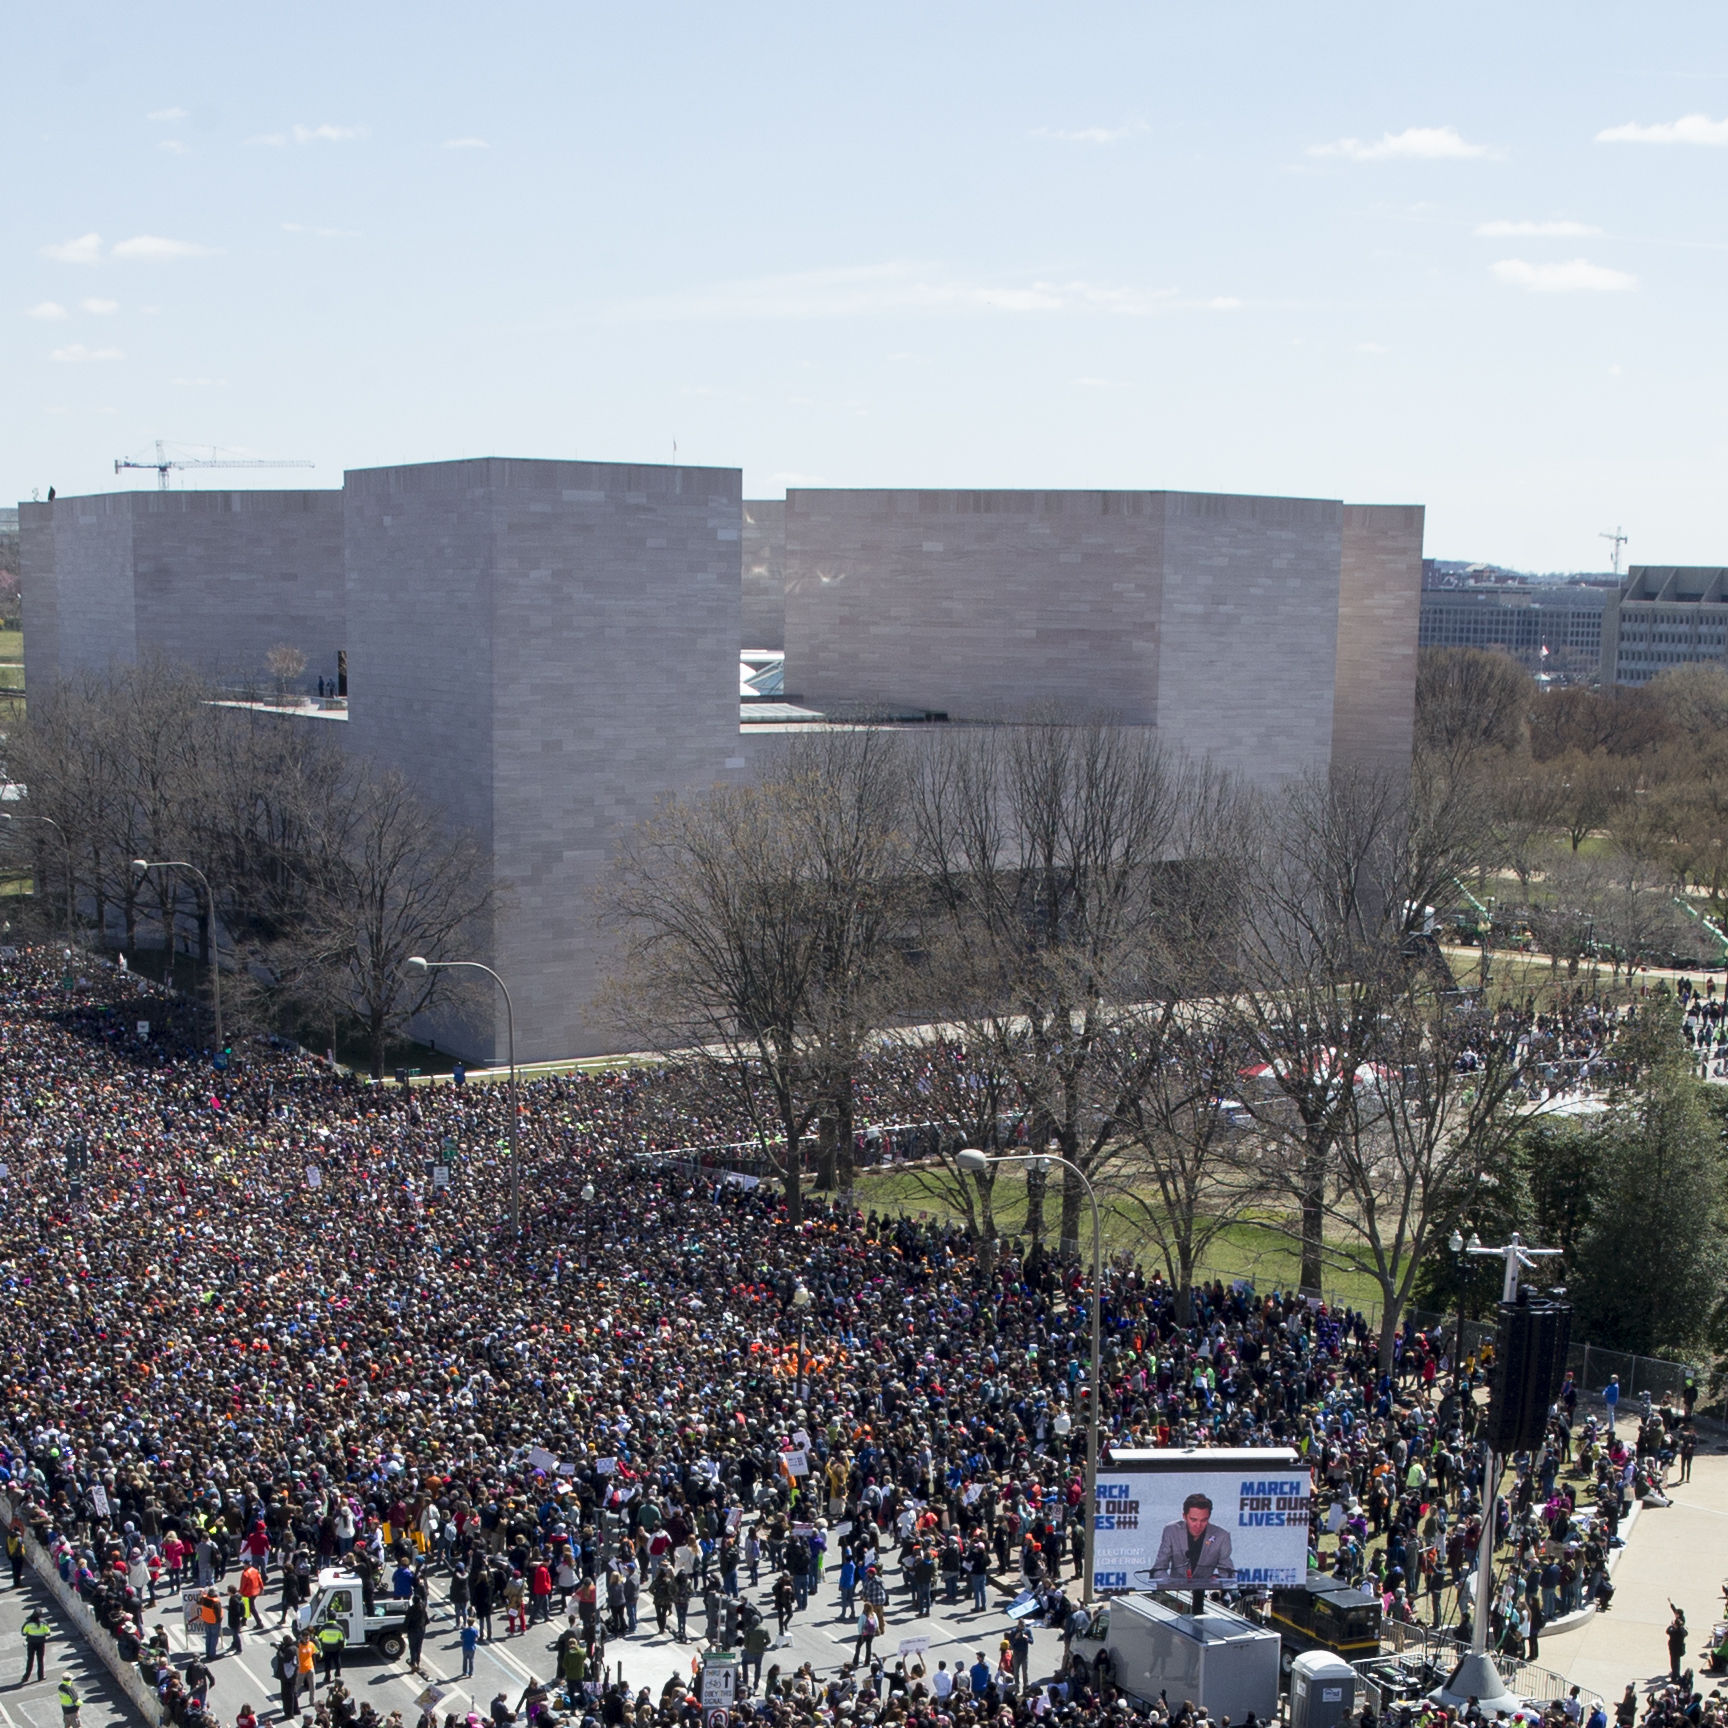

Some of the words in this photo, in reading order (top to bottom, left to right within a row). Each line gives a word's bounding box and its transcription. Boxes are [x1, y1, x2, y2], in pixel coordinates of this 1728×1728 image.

[1240, 1481, 1301, 1496] MARCH
[1106, 1500, 1140, 1514] OUR
[1239, 1497, 1273, 1511] FOR
[1276, 1496, 1310, 1511] OUR
[1238, 1512, 1285, 1527] LIVES
[1097, 1547, 1144, 1557] ELECTION?
[704, 1690, 718, 1698] OBEY
